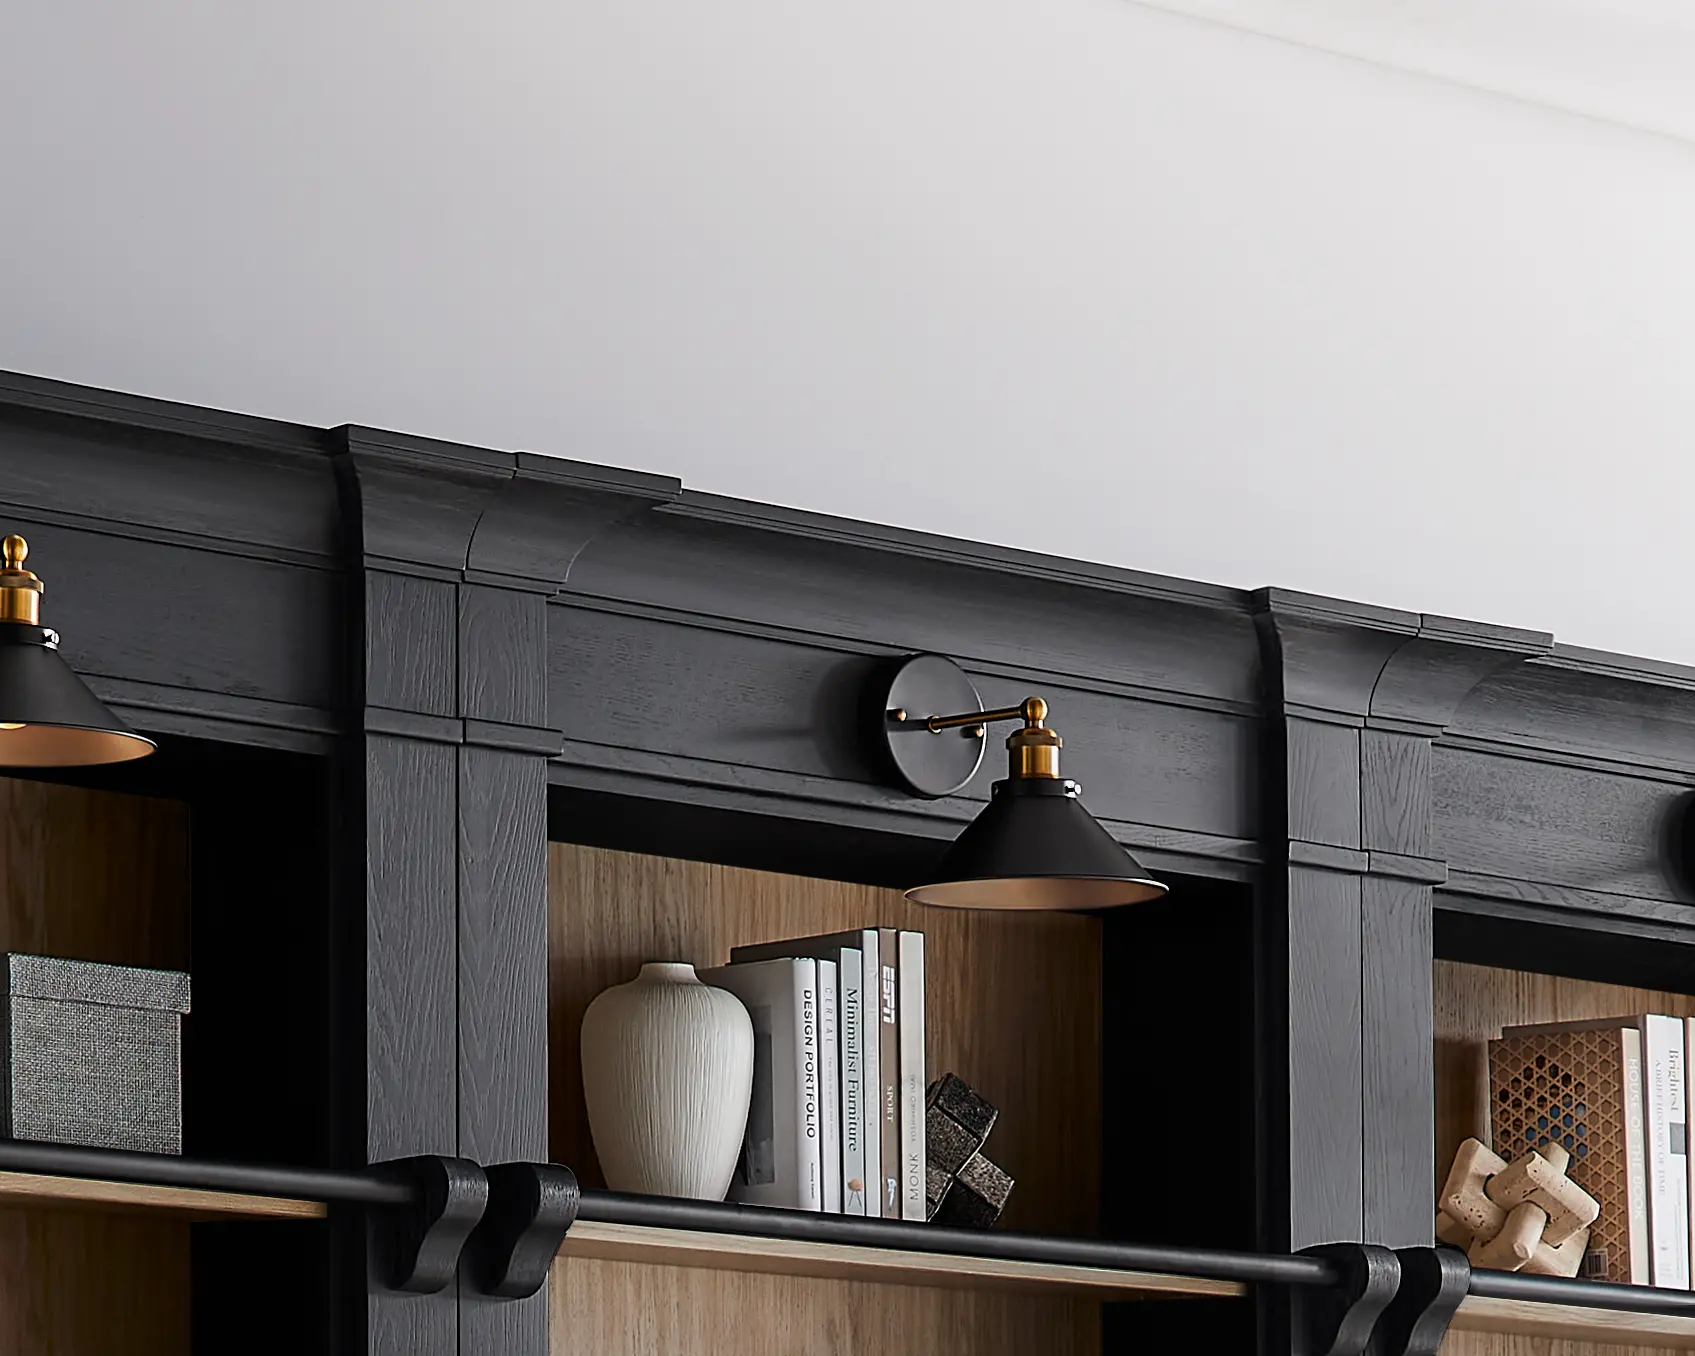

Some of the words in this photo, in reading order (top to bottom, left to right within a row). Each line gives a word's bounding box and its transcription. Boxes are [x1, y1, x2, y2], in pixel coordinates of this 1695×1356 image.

[804, 989, 814, 1046] DESIGN
[883, 965, 895, 1024] ESPN
[846, 988, 859, 1073] Minimalist
[805, 1051, 816, 1138] PORTFOLIO
[886, 1085, 894, 1122] SPORT
[1628, 1058, 1639, 1110] HOUSE
[847, 1080, 860, 1152] Furniture
[1631, 1117, 1640, 1137] OF
[909, 1153, 920, 1201] MONK
[1632, 1141, 1643, 1172] THE
[1633, 1176, 1644, 1221] BOOK
